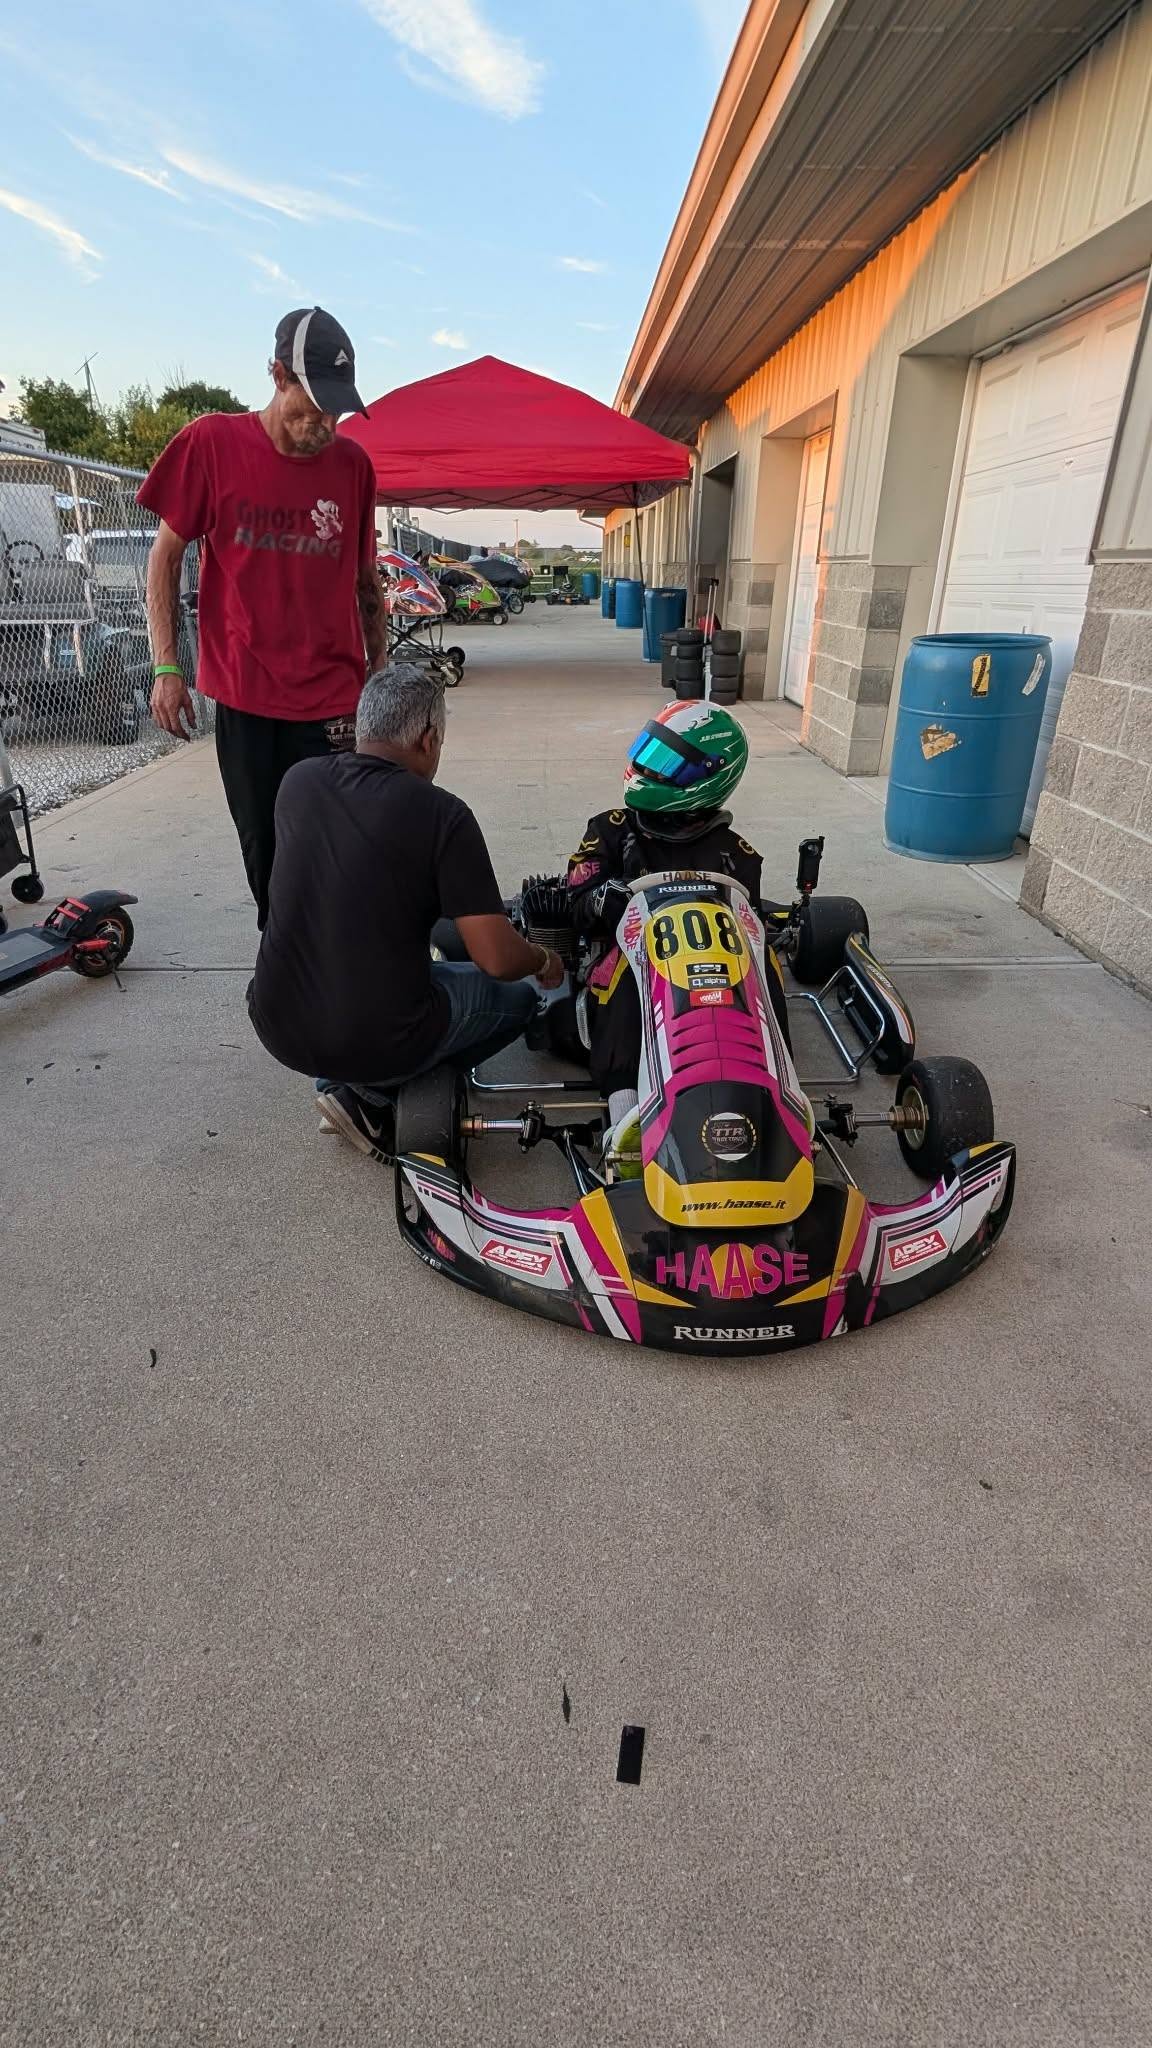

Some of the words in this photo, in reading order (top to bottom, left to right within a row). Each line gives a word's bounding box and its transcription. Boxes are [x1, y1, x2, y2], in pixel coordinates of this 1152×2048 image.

[234, 527, 343, 557] RACING
[662, 871, 711, 882] HAASE
[658, 885, 717, 893] RUNNER
[653, 909, 743, 960] 808
[704, 977, 726, 985] alpha
[714, 1128, 743, 1136] TTR
[681, 1199, 787, 1212] www.haase.it
[485, 1245, 548, 1268] APEX
[894, 1234, 940, 1262] APEX
[656, 1243, 810, 1299] HAASE
[673, 1324, 795, 1342] RUNNER
